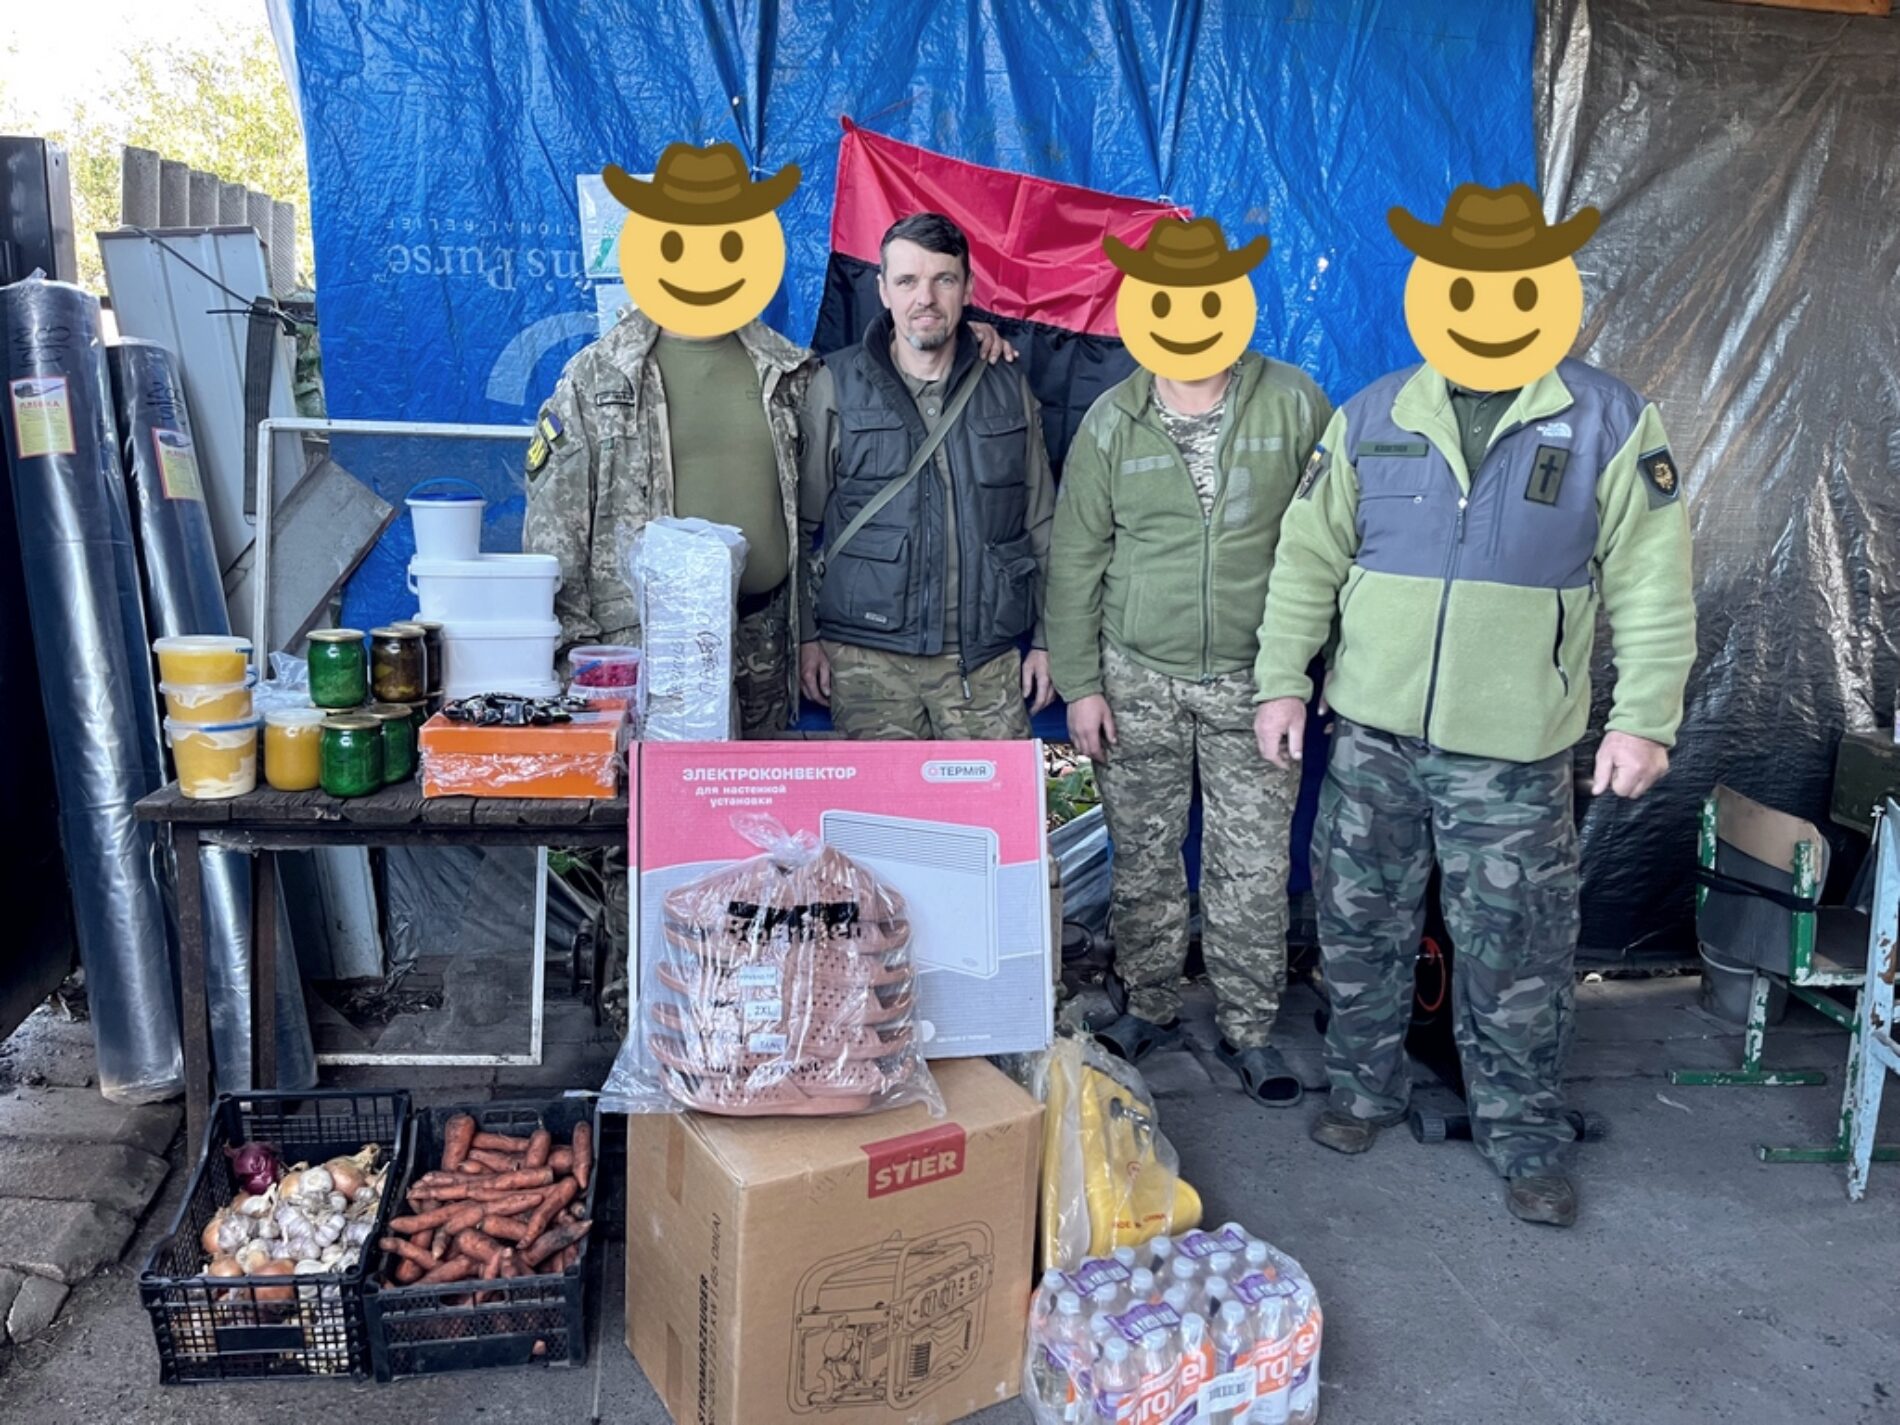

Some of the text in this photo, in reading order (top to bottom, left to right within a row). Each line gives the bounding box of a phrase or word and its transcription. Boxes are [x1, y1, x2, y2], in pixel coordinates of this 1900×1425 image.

[388, 217, 577, 238] TIONAL RELIEF
[682, 766, 857, 781] ЭЛЕКТРОКОНВЕКТОР
[695, 784, 787, 796] для настенной
[710, 796, 773, 808] установки
[875, 1151, 957, 1190] STIER
